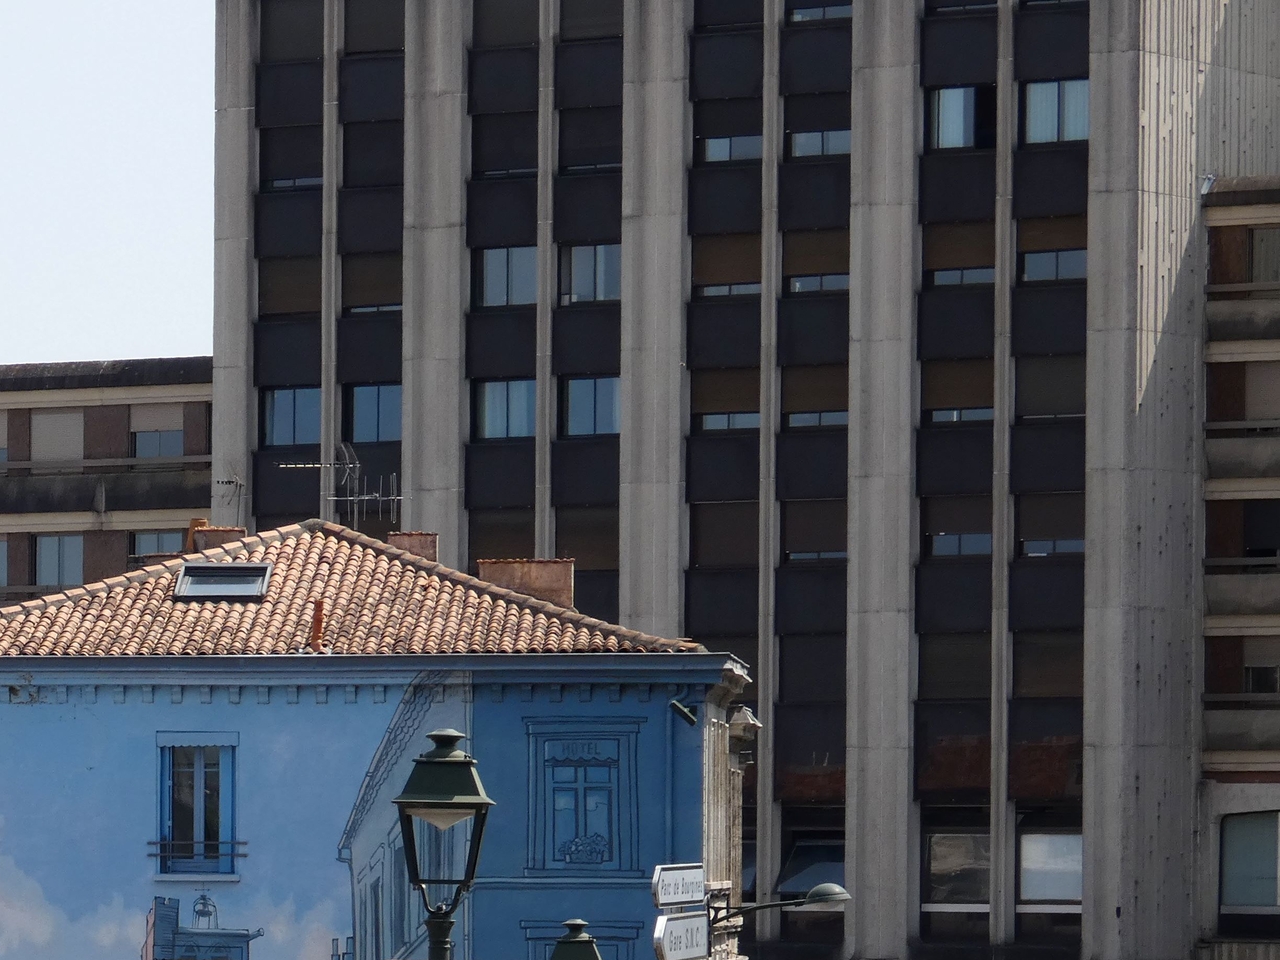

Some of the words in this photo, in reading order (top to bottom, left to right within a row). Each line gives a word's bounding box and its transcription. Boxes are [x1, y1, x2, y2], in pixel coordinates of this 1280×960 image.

[660, 879, 671, 896] Parc
[673, 878, 680, 895] de
[669, 930, 682, 951] Gare
